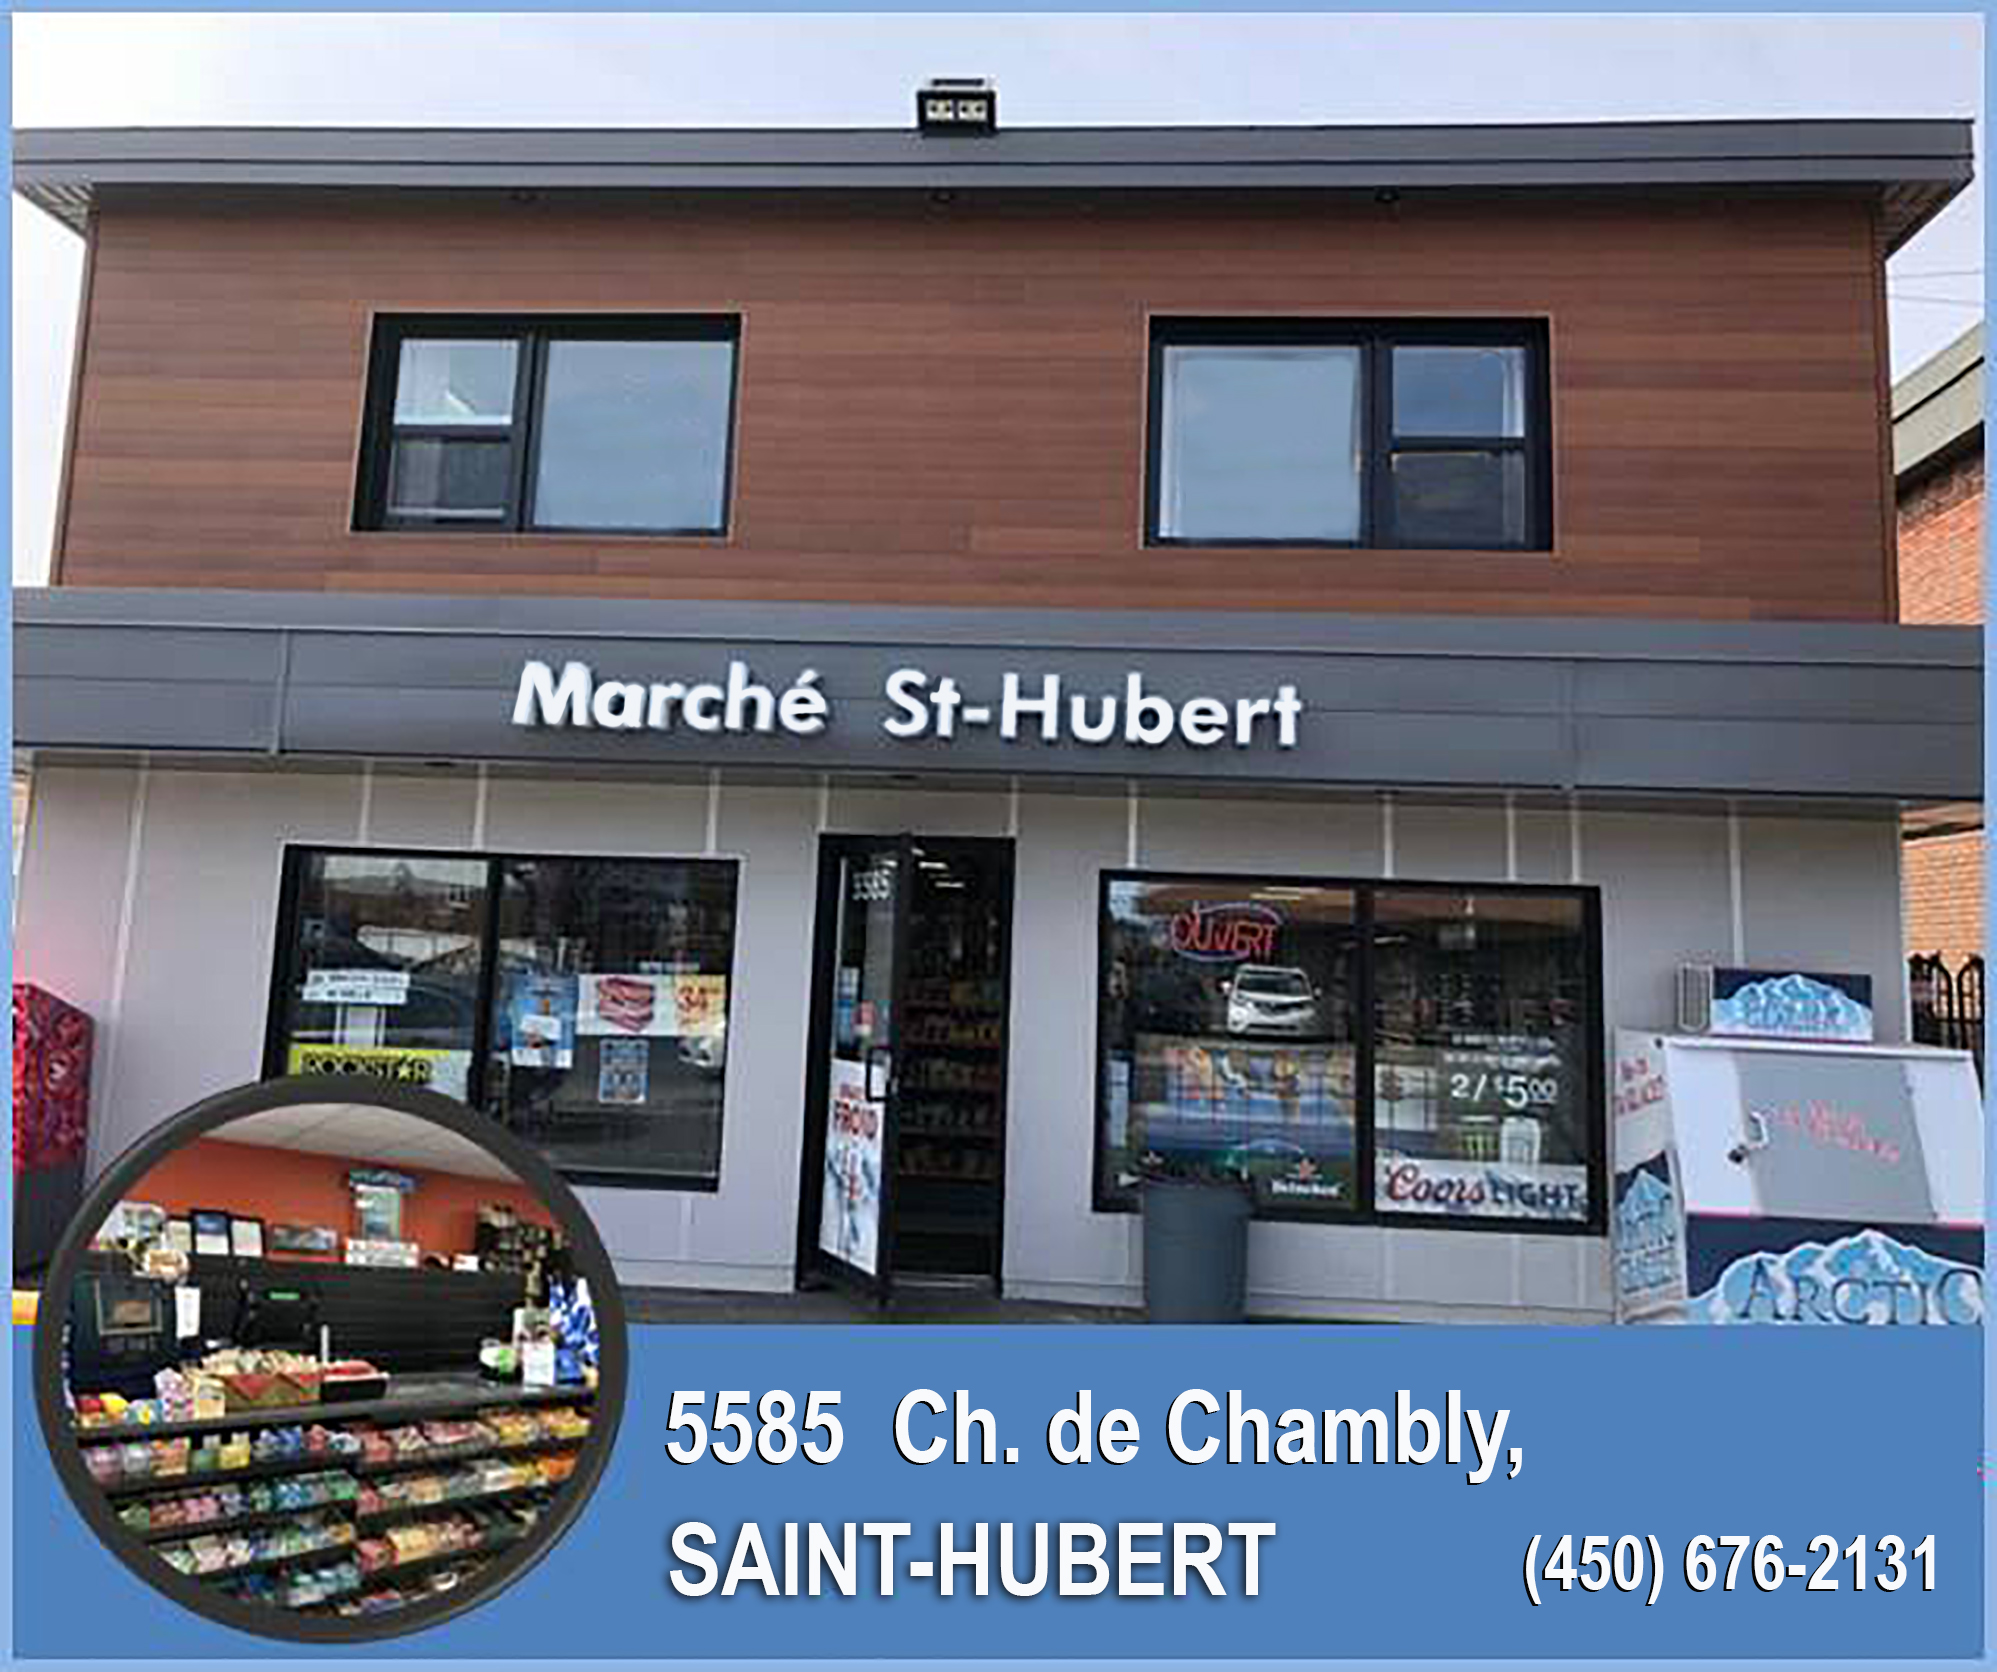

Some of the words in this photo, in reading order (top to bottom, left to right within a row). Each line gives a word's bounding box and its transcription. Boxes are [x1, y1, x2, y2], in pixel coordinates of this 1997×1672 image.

[512, 659, 828, 732] Marché
[884, 668, 1303, 748] St-Hubert
[1171, 910, 1277, 962] OUVERT
[1386, 1162, 1486, 1204] Coors
[1487, 1170, 1581, 1208] LIGHT
[1738, 1257, 1985, 1325] ARCTIC
